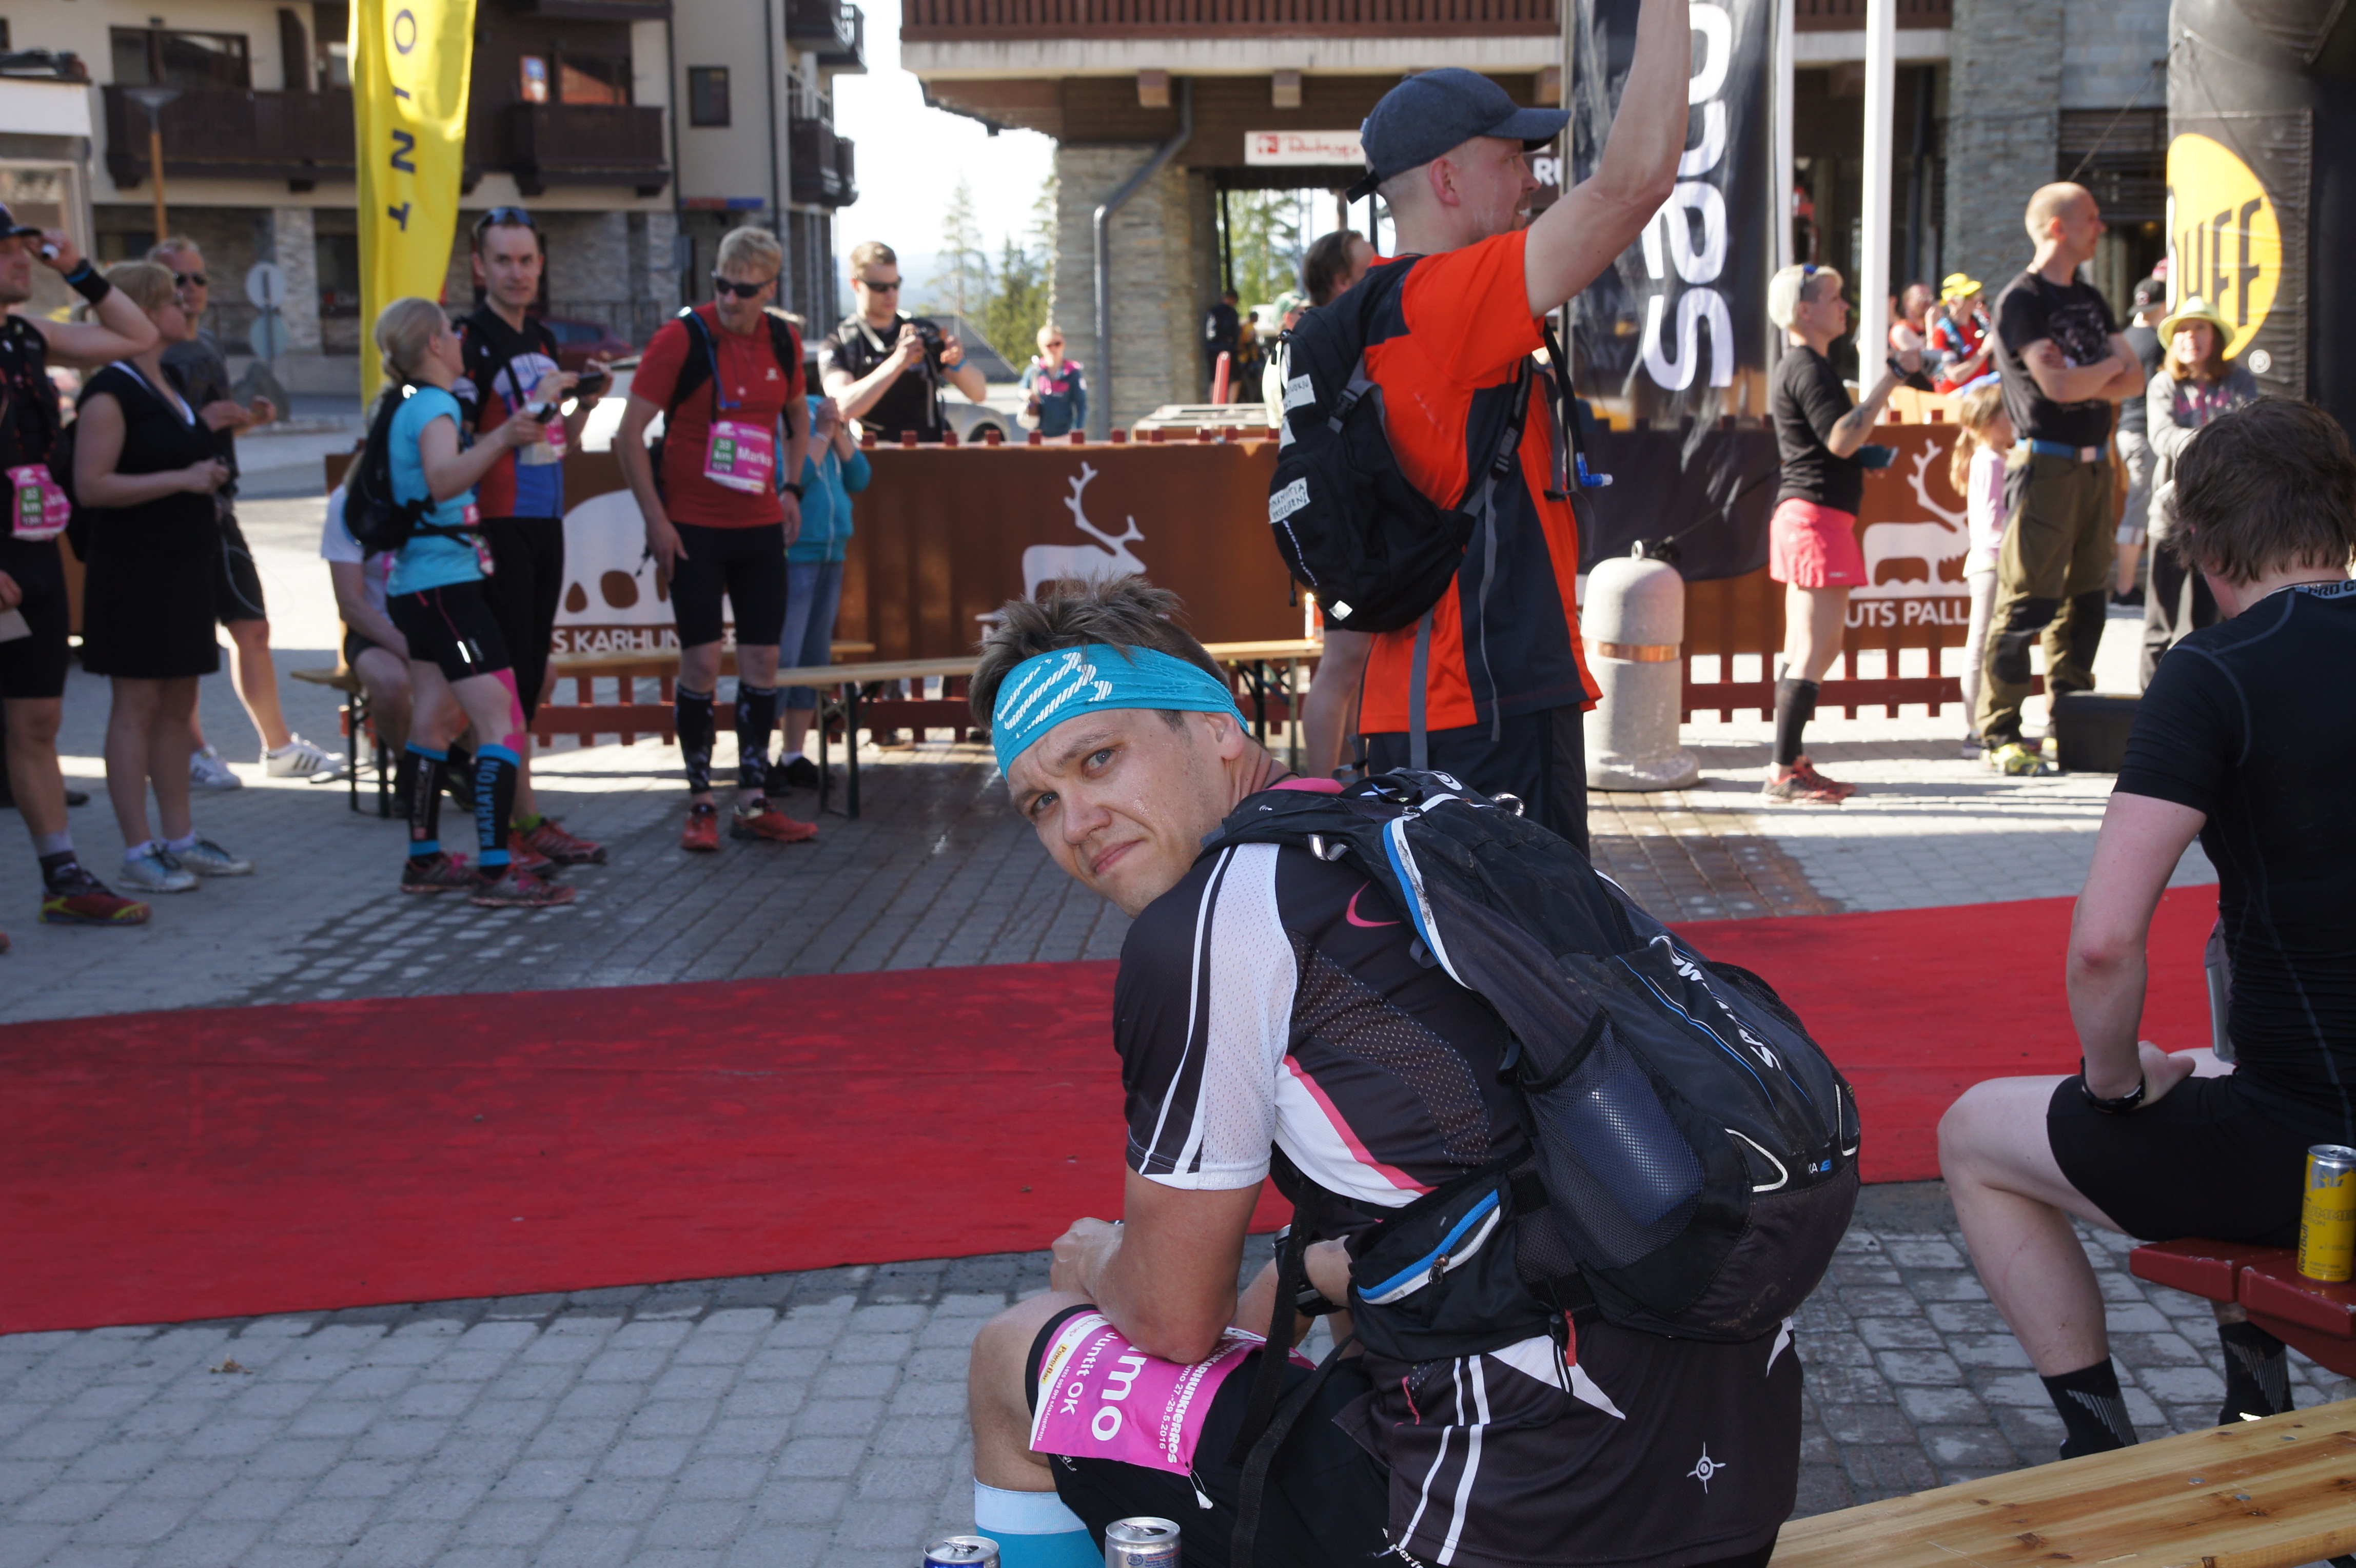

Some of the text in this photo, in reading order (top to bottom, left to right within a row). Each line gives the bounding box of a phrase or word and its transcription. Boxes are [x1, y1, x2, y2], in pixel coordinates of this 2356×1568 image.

[2308, 584, 2340, 596] PRO
[1076, 1332, 1119, 1377] Juntit
[1051, 1389, 1060, 1400] 040
[1059, 1382, 1084, 1416] OK
